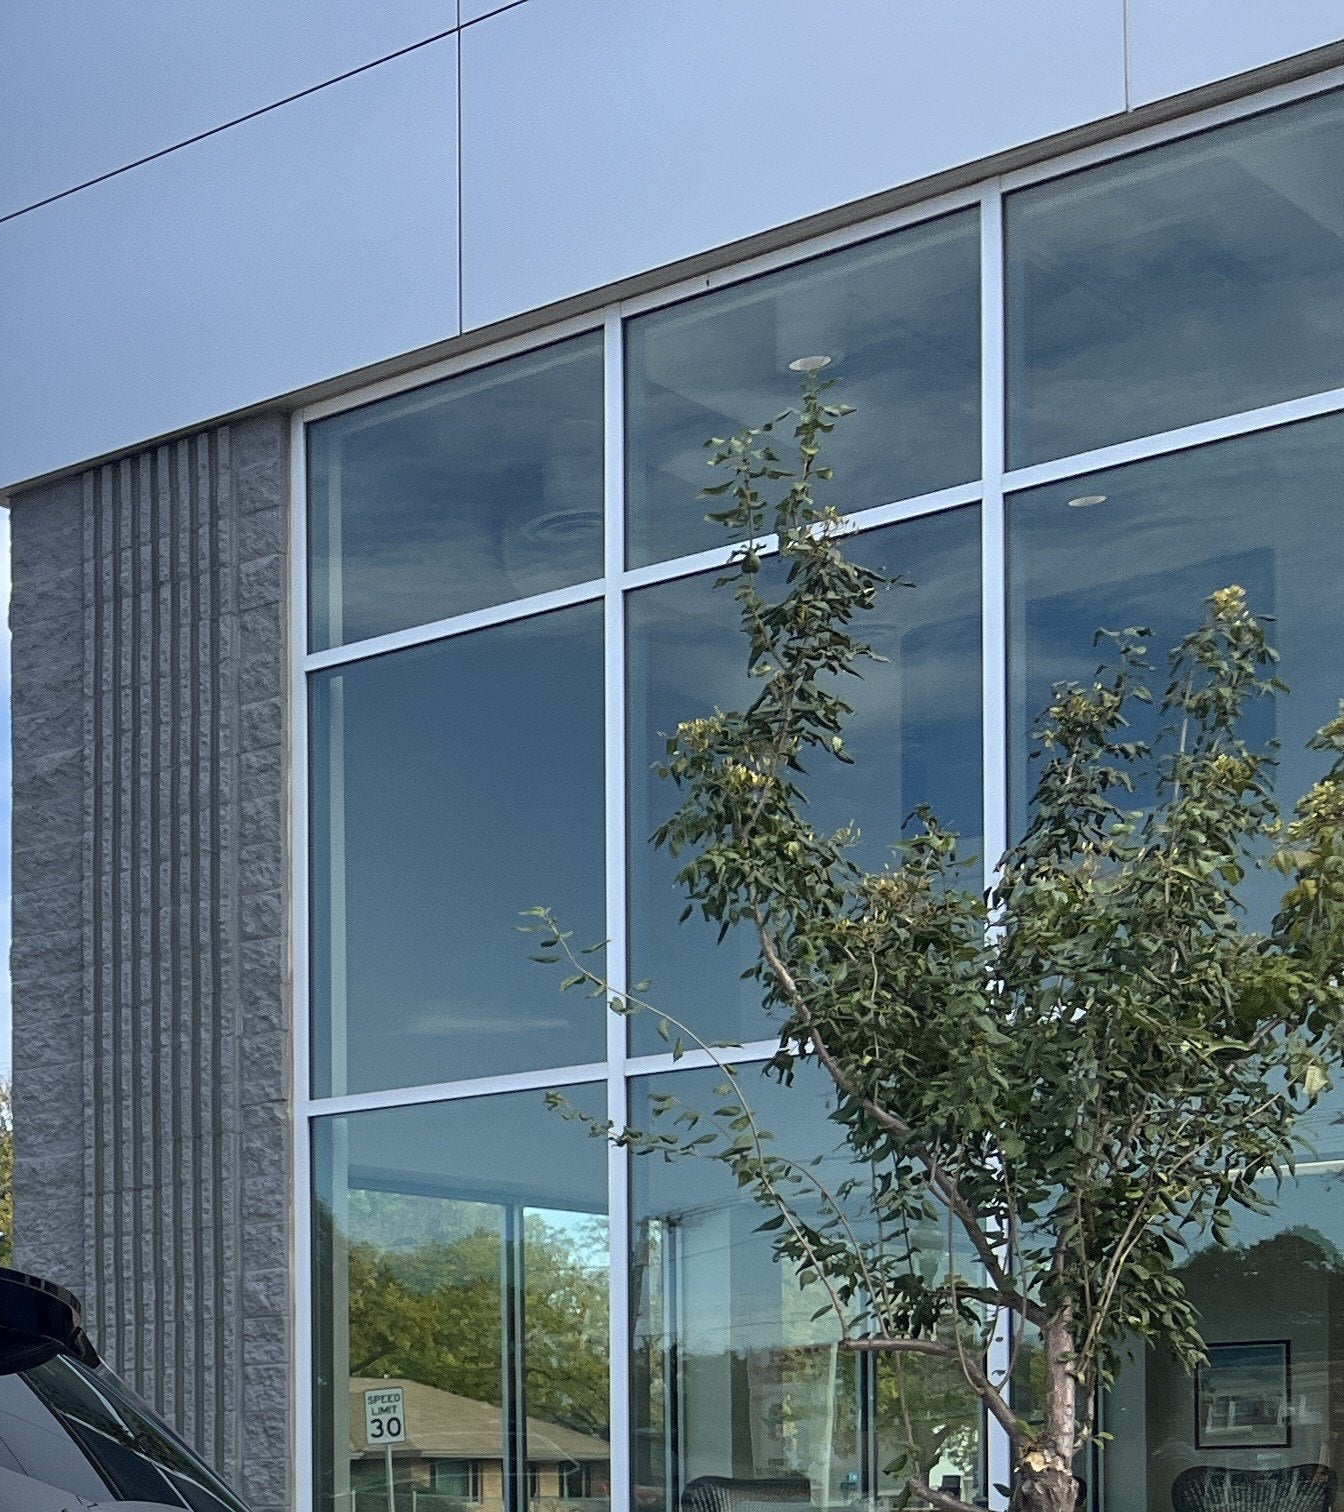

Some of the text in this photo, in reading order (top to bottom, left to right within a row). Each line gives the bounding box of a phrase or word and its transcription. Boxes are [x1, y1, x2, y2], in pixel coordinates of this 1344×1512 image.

[367, 1393, 401, 1404] SPEED
[371, 1405, 397, 1415] LIMIT
[370, 1417, 401, 1438] 30
